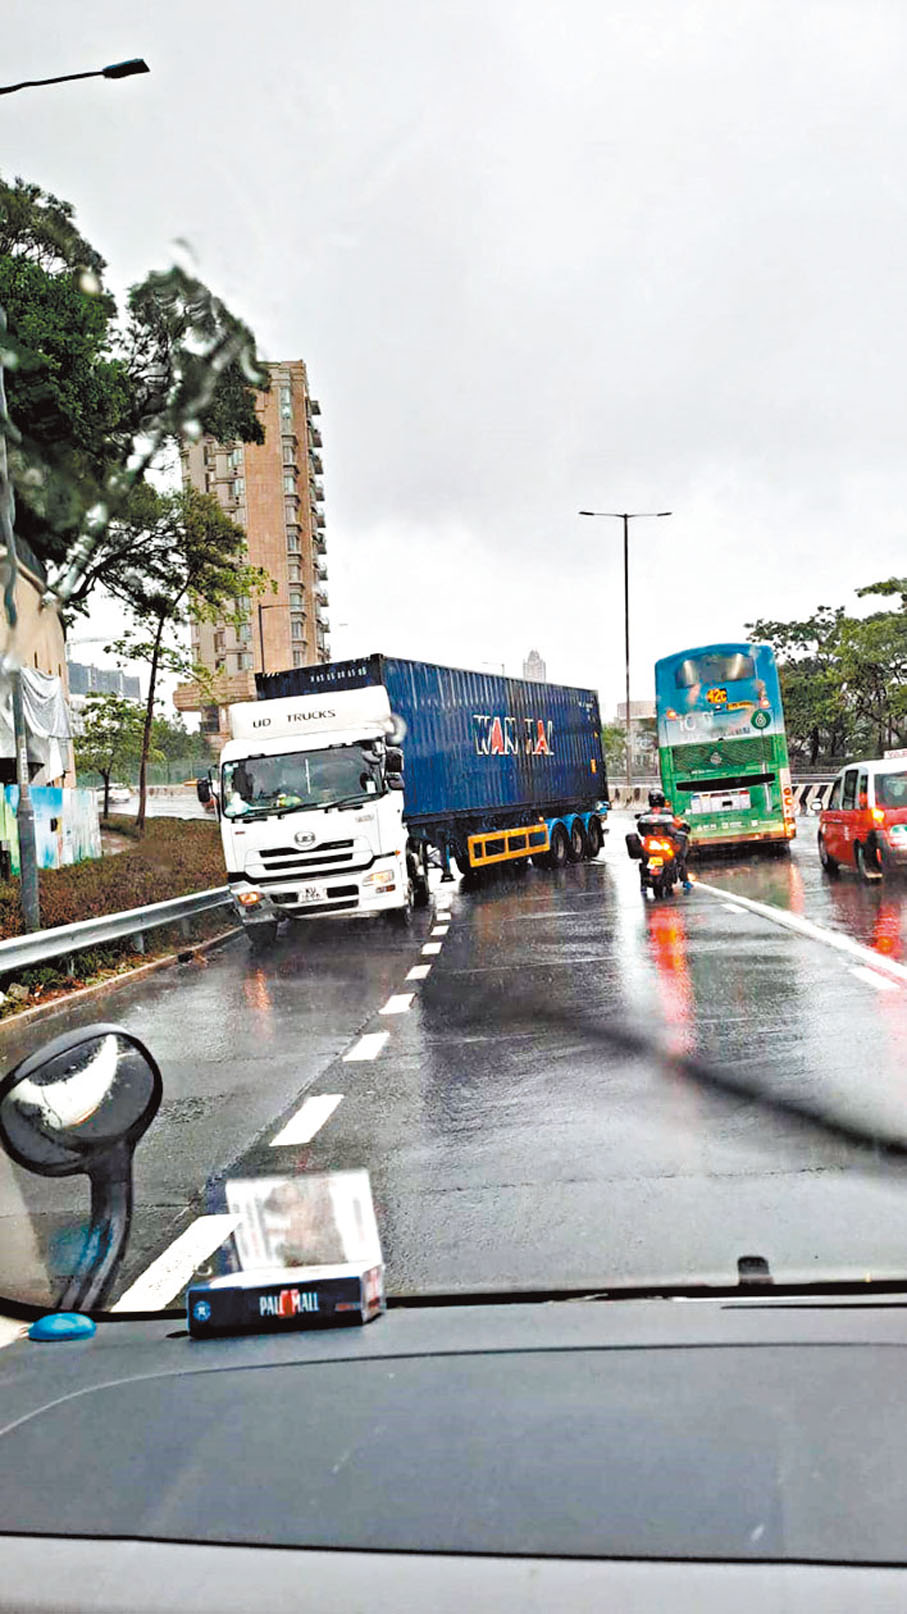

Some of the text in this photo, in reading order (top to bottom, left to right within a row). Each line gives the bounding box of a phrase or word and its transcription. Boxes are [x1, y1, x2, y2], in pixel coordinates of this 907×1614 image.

[252, 709, 337, 729] UD TRUCKS
[473, 714, 519, 755] WAN
[259, 1295, 285, 1317] PALL
[292, 1291, 319, 1313] MALL
